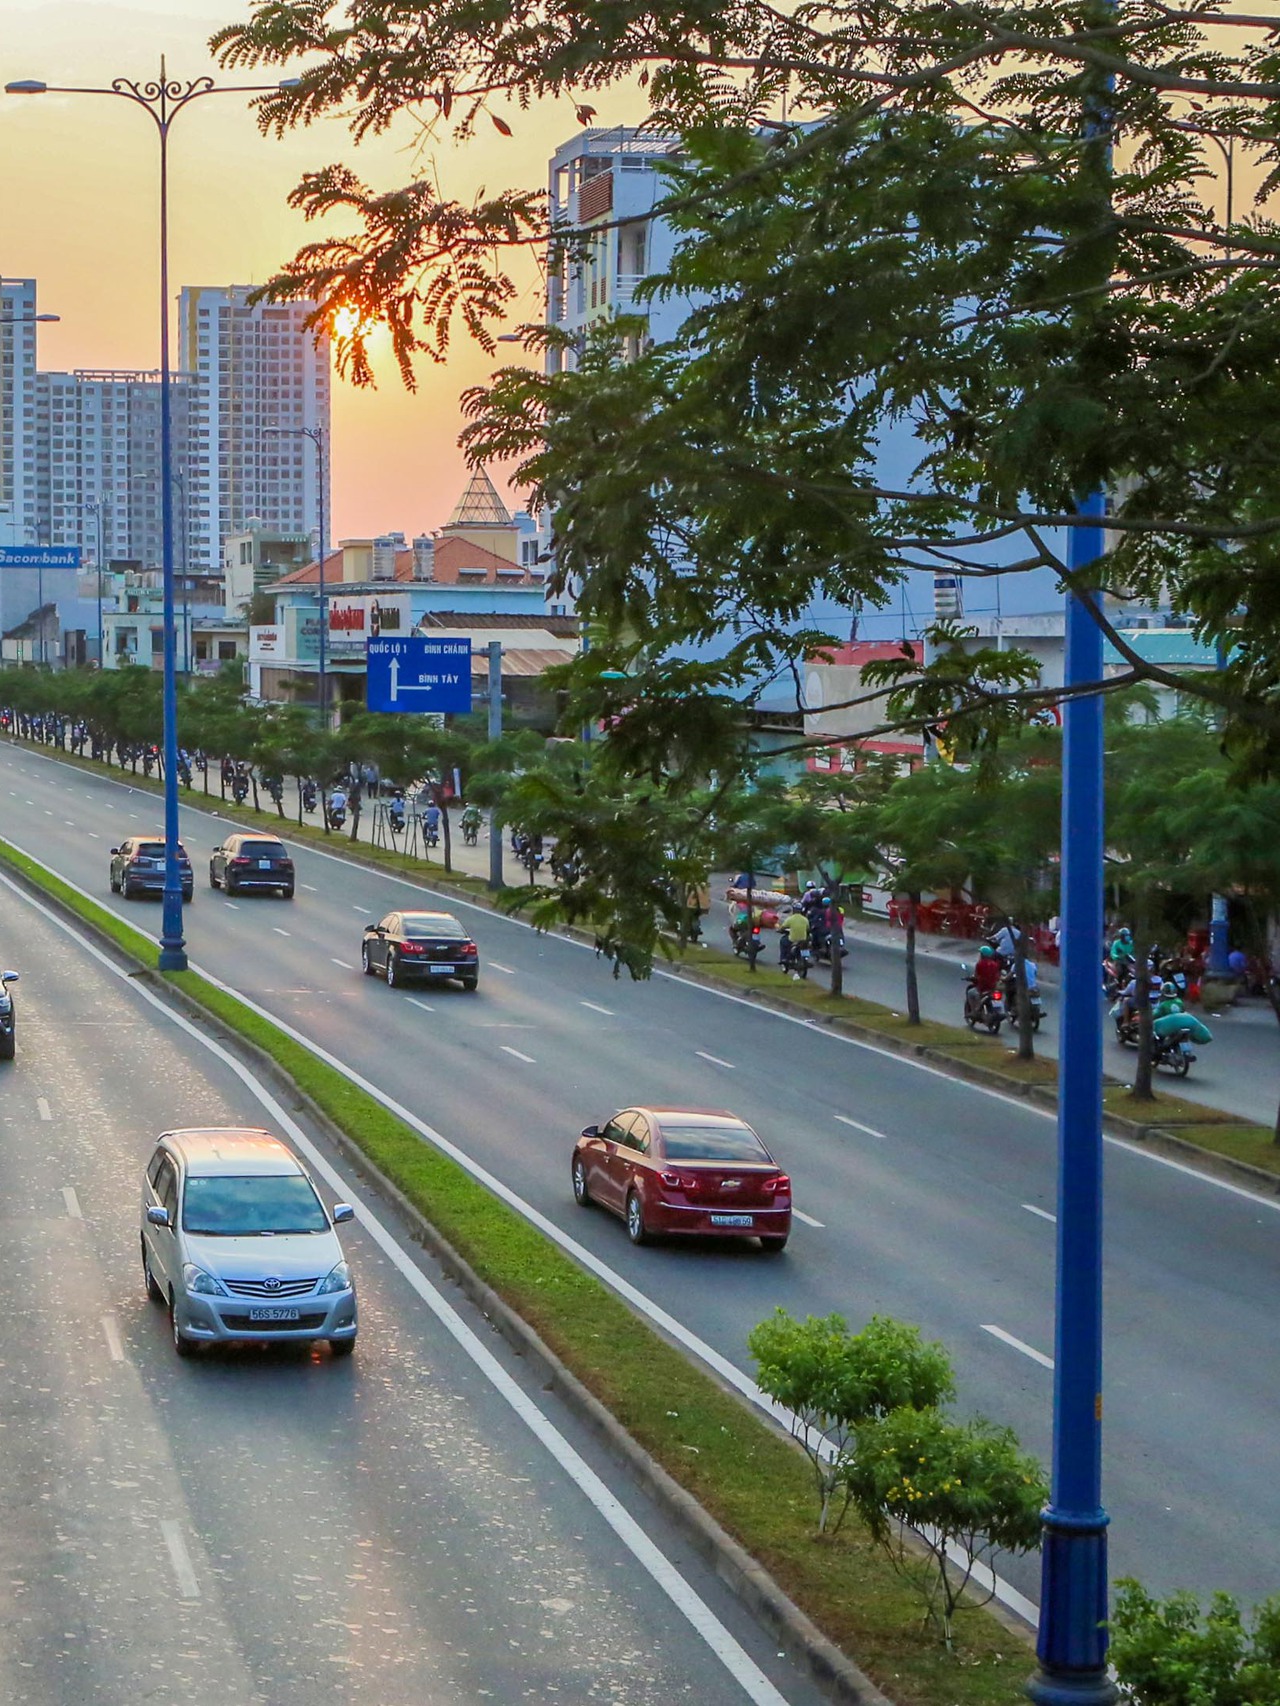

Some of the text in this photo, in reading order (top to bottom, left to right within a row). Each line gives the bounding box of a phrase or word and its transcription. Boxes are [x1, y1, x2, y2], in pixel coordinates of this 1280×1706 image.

[369, 641, 390, 654] QUỐC
[391, 642, 401, 656] LỘ
[403, 644, 408, 654] 1
[424, 642, 469, 654] BÌNH CHÁNH
[418, 672, 459, 684] BÌNH TÂY
[252, 1309, 297, 1319] 56S 5776
